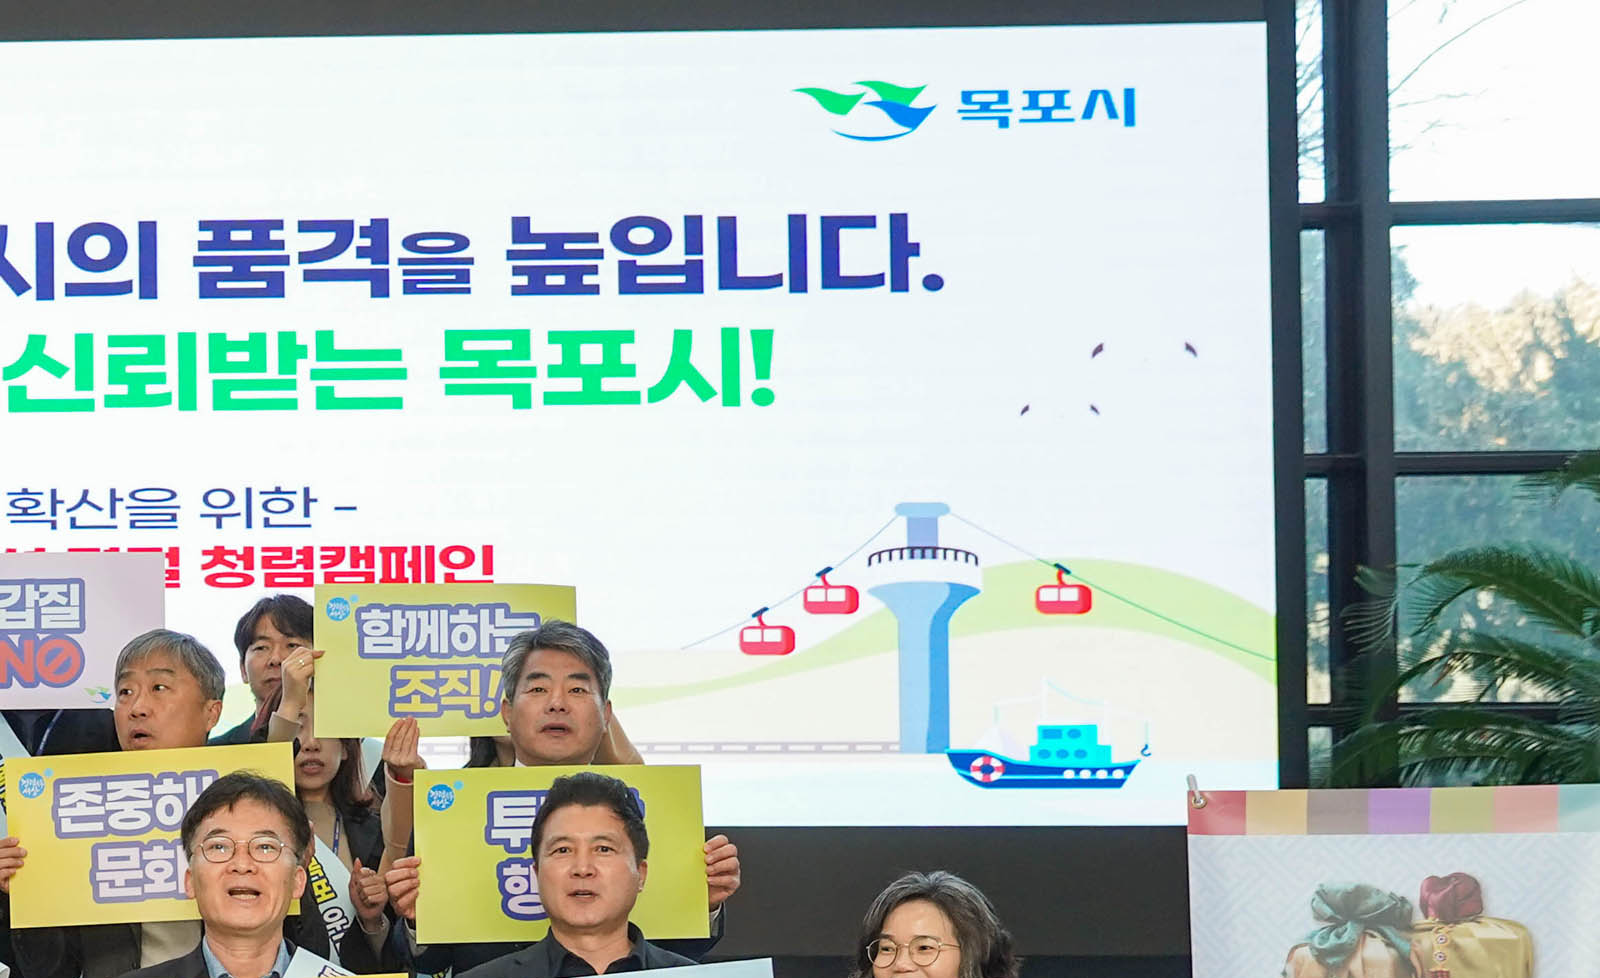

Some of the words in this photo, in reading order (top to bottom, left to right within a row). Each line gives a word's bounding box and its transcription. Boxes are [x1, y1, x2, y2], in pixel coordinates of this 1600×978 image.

[957, 87, 1137, 129] 목포시
[192, 216, 475, 299] 품격을
[505, 213, 945, 297] 높입니다.
[2, 329, 408, 414] 신뢰받는
[440, 326, 776, 409] 목포시!
[6, 487, 181, 531] 확산을
[200, 485, 317, 530] 위한
[200, 543, 494, 589] 청렴캠페인
[394, 668, 502, 714] 조직!
[57, 776, 213, 834] 존중하
